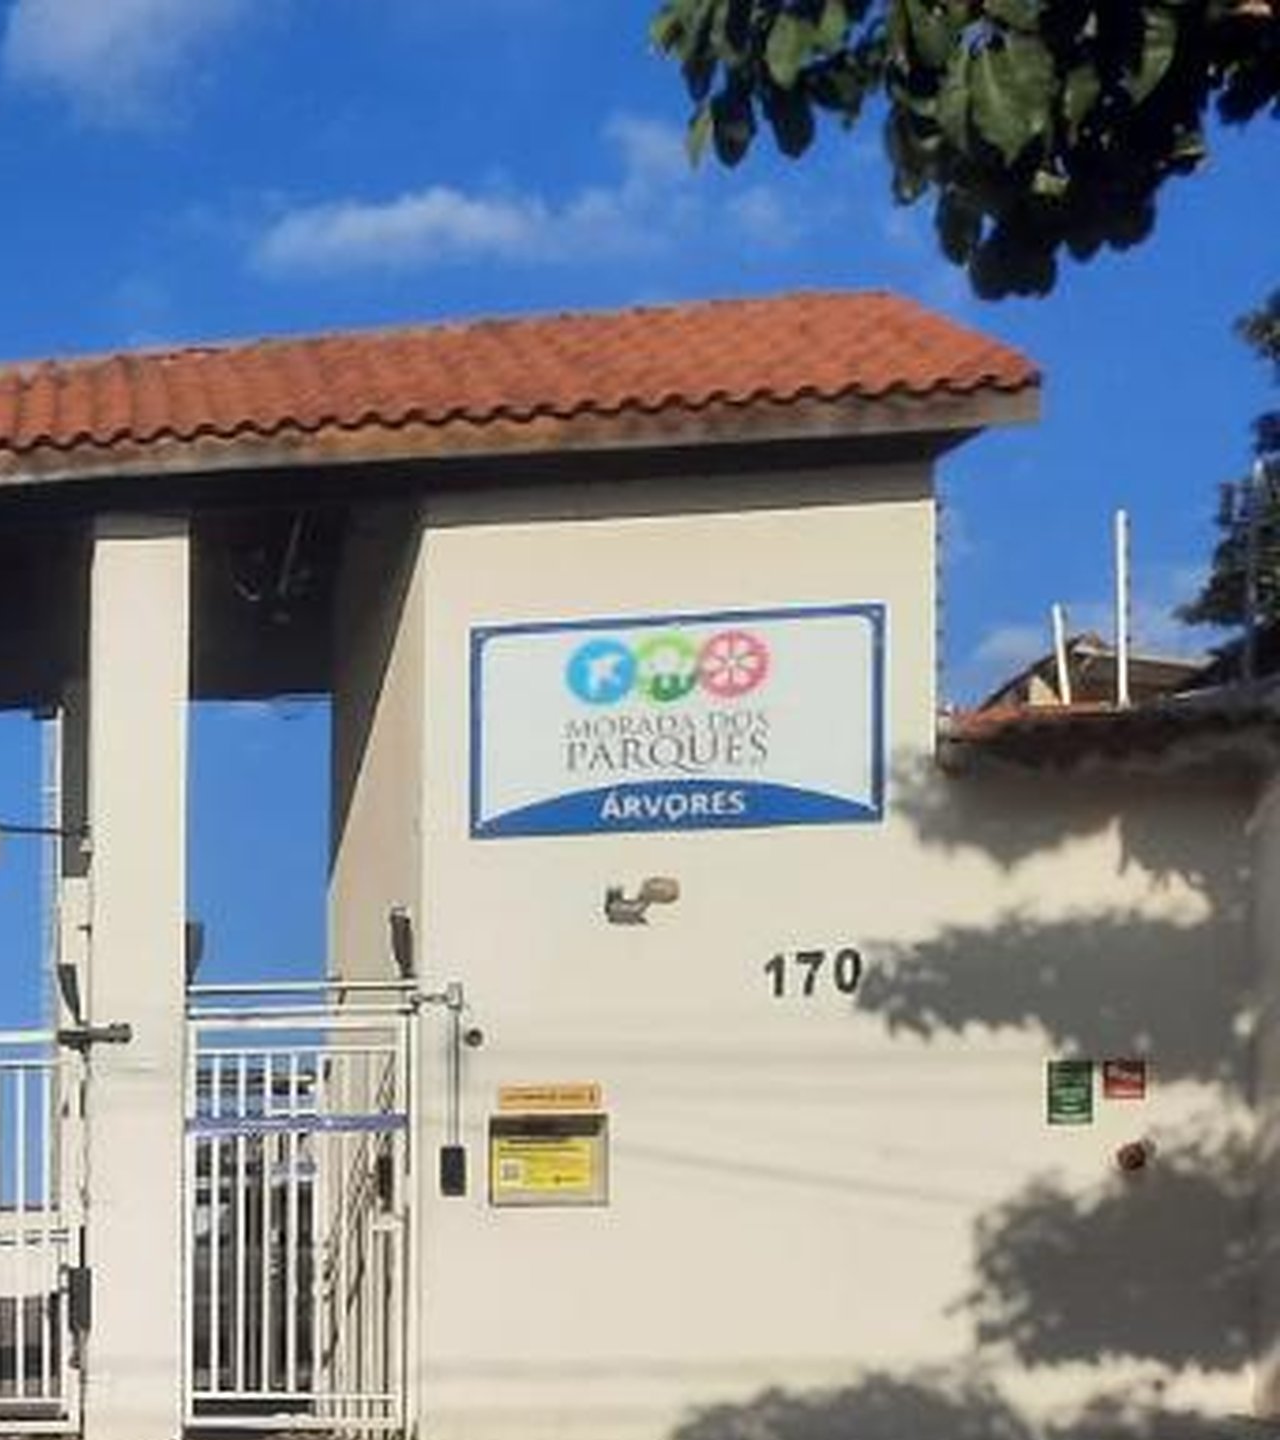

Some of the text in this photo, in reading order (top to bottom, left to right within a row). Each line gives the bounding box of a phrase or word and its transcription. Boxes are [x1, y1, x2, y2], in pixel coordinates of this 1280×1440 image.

[564, 710, 771, 740] MORADA DOS
[564, 730, 769, 774] PARQUES
[600, 790, 747, 822] ÁRVORES
[763, 948, 862, 998] 170
